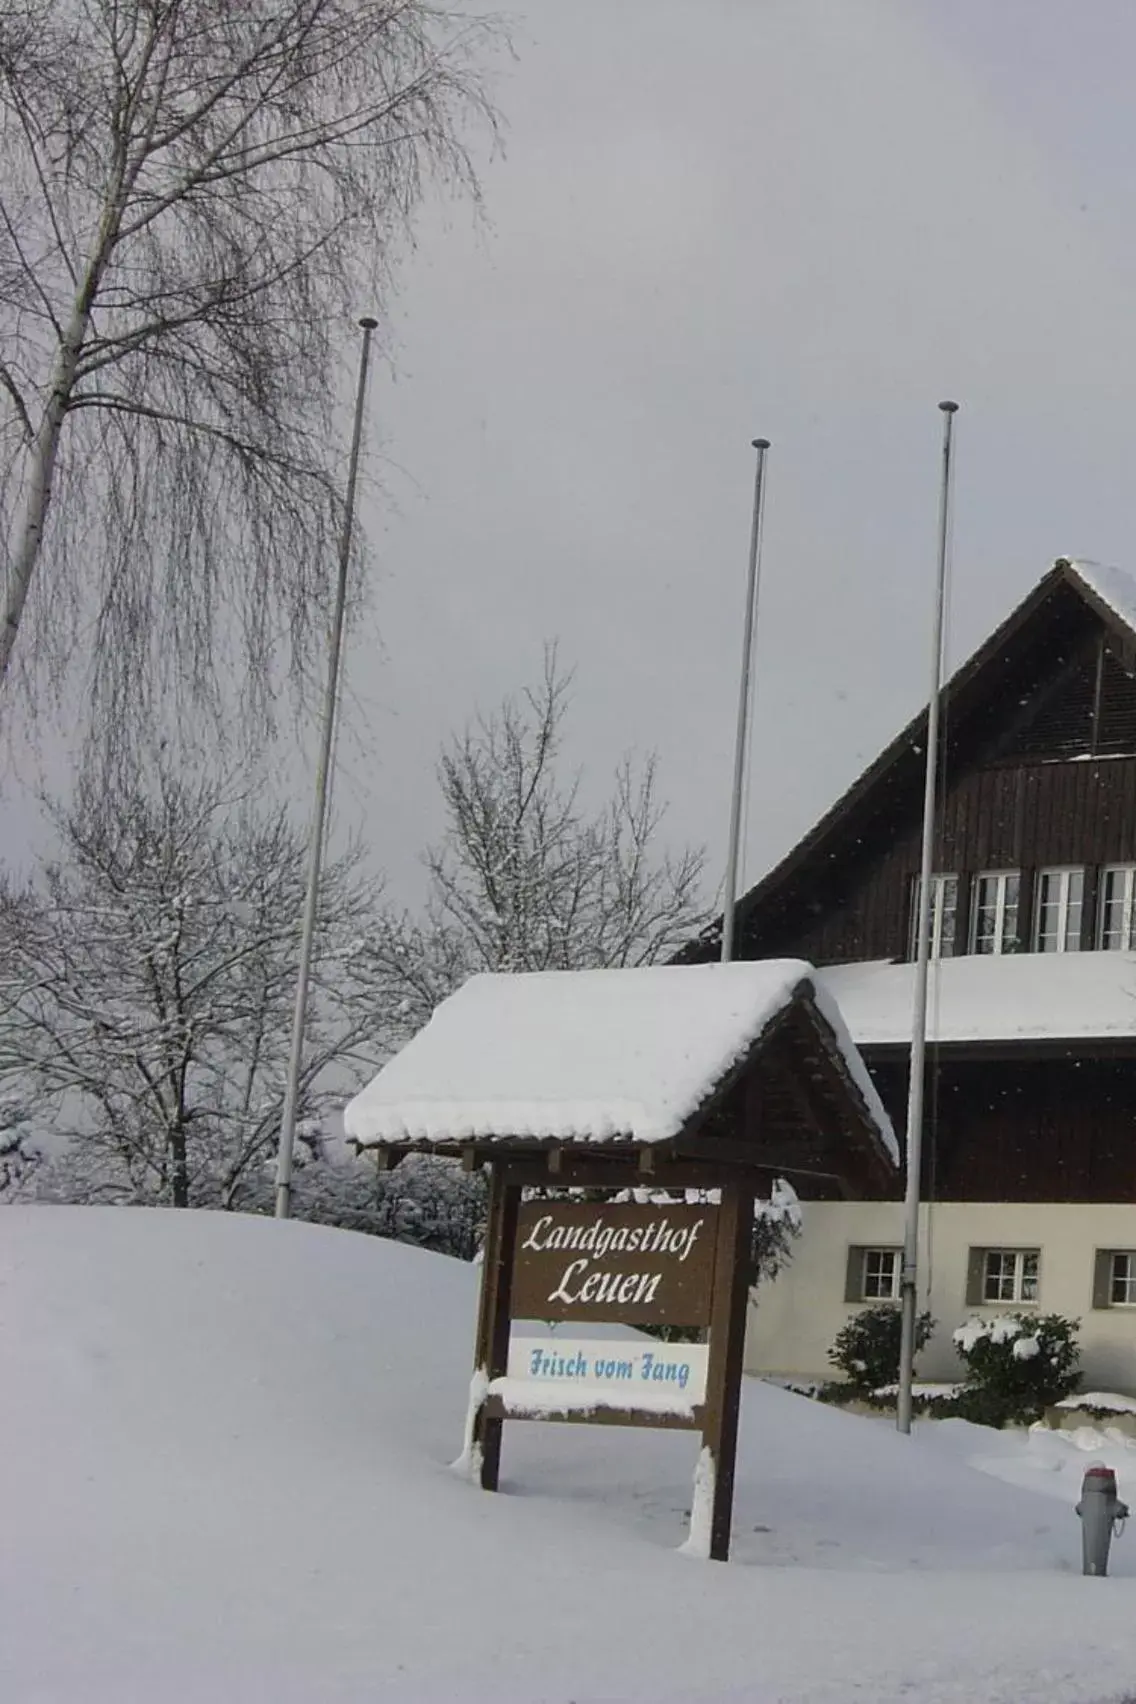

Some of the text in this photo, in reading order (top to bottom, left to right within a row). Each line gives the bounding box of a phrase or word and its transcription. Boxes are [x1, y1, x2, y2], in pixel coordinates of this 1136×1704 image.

[522, 1216, 703, 1261] Landgasthof
[547, 1259, 662, 1304] Leuen
[531, 1349, 690, 1388] Frisch vom Fang
